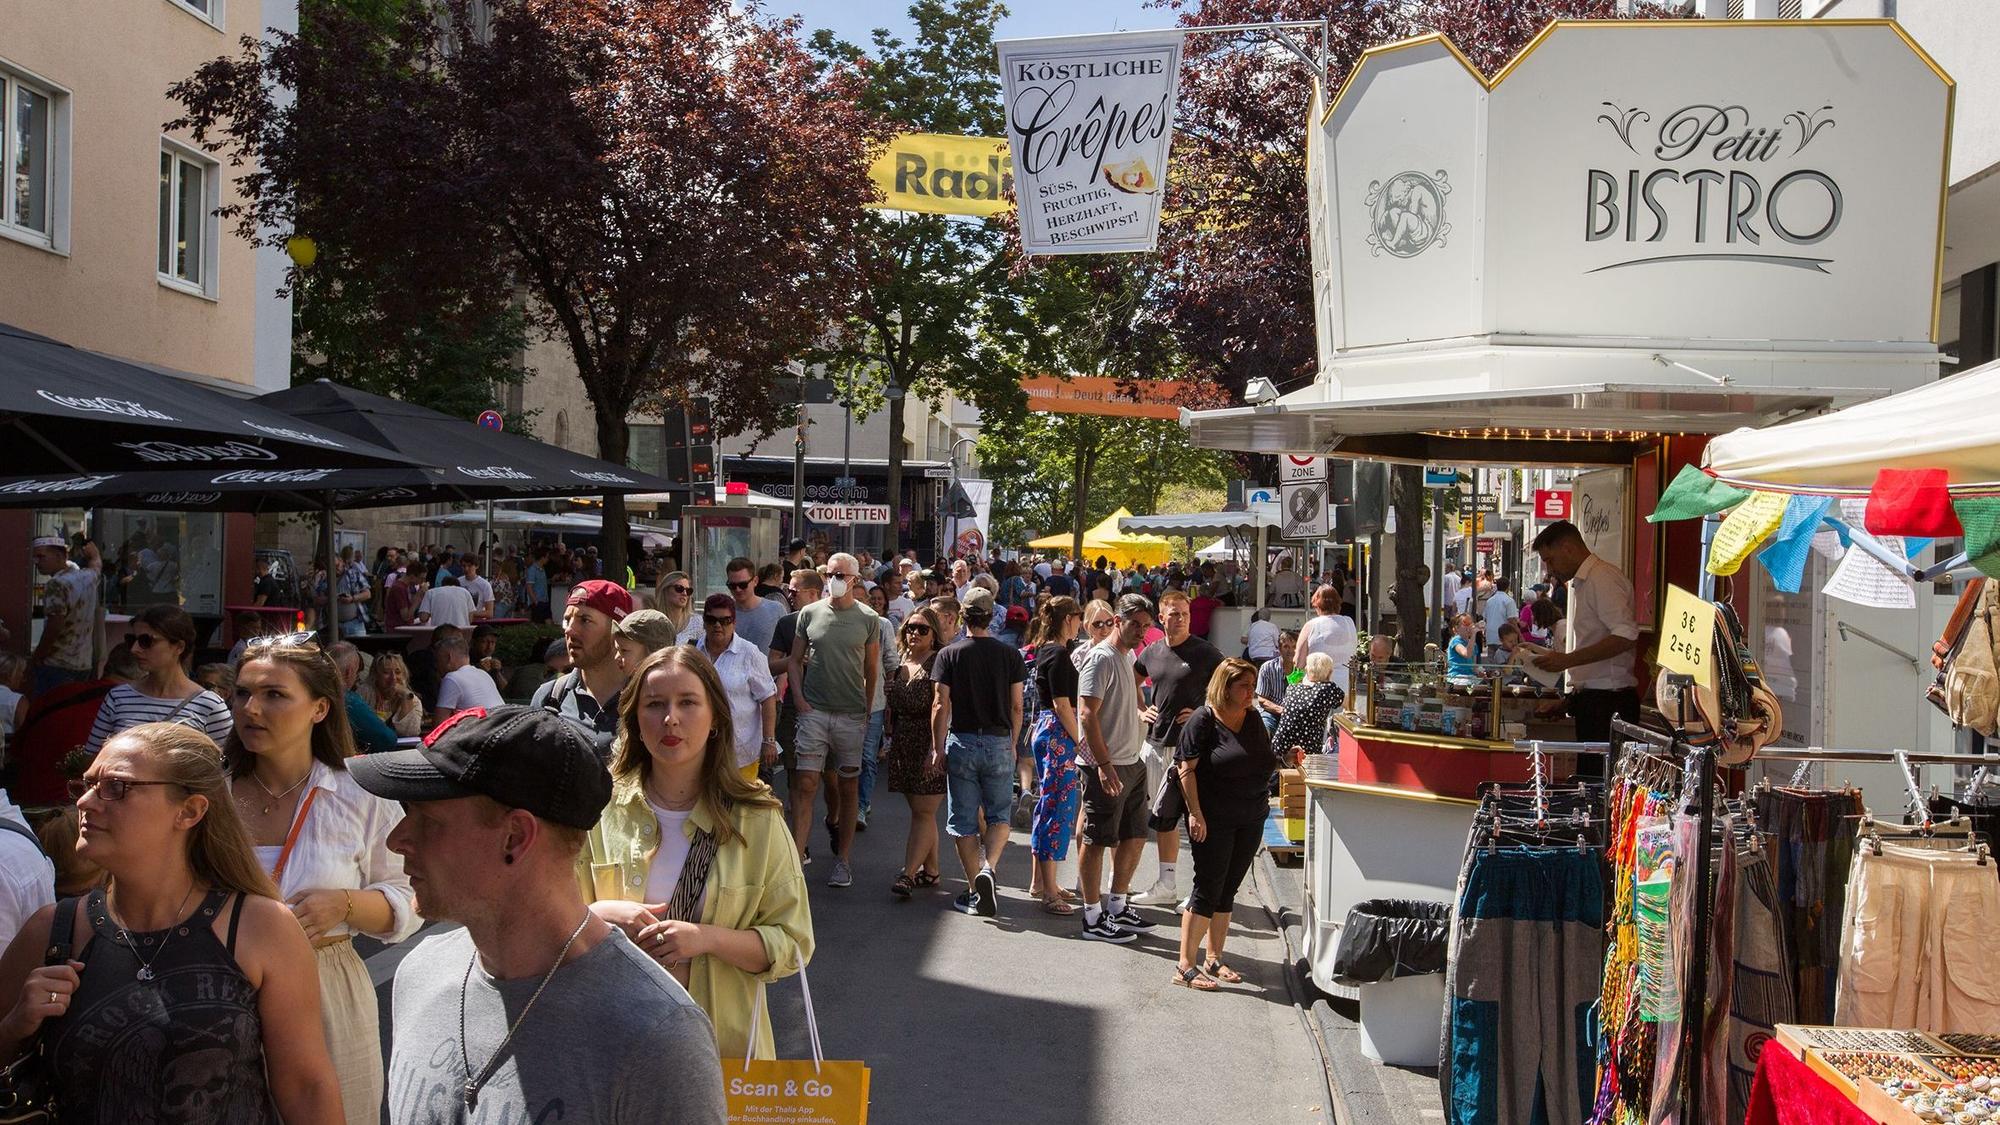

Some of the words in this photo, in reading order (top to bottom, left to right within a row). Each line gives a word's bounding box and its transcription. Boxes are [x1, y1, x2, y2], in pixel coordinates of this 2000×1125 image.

[1018, 59, 1164, 82] KÖSTLICHE
[1012, 80, 1168, 184] Crêpes
[1654, 104, 1783, 162] Petit
[1039, 181, 1078, 198] SÜSS,
[1042, 187, 1112, 213] FRUCHTIG,
[1047, 201, 1123, 229] HERZHAFT,
[1585, 168, 1843, 246] BISTRO
[1050, 210, 1139, 245] BESCHWIPST!
[1292, 467, 1315, 478] ZONE
[816, 508, 887, 521] TOILETTEN
[1294, 525, 1317, 535] ZONE
[729, 1078, 778, 1097] Scan
[784, 1079, 798, 1097] &
[804, 1080, 833, 1097] Go
[742, 1115, 796, 1124] Buchhandlung
[745, 1105, 758, 1113] Mit
[798, 1106, 814, 1114] App
